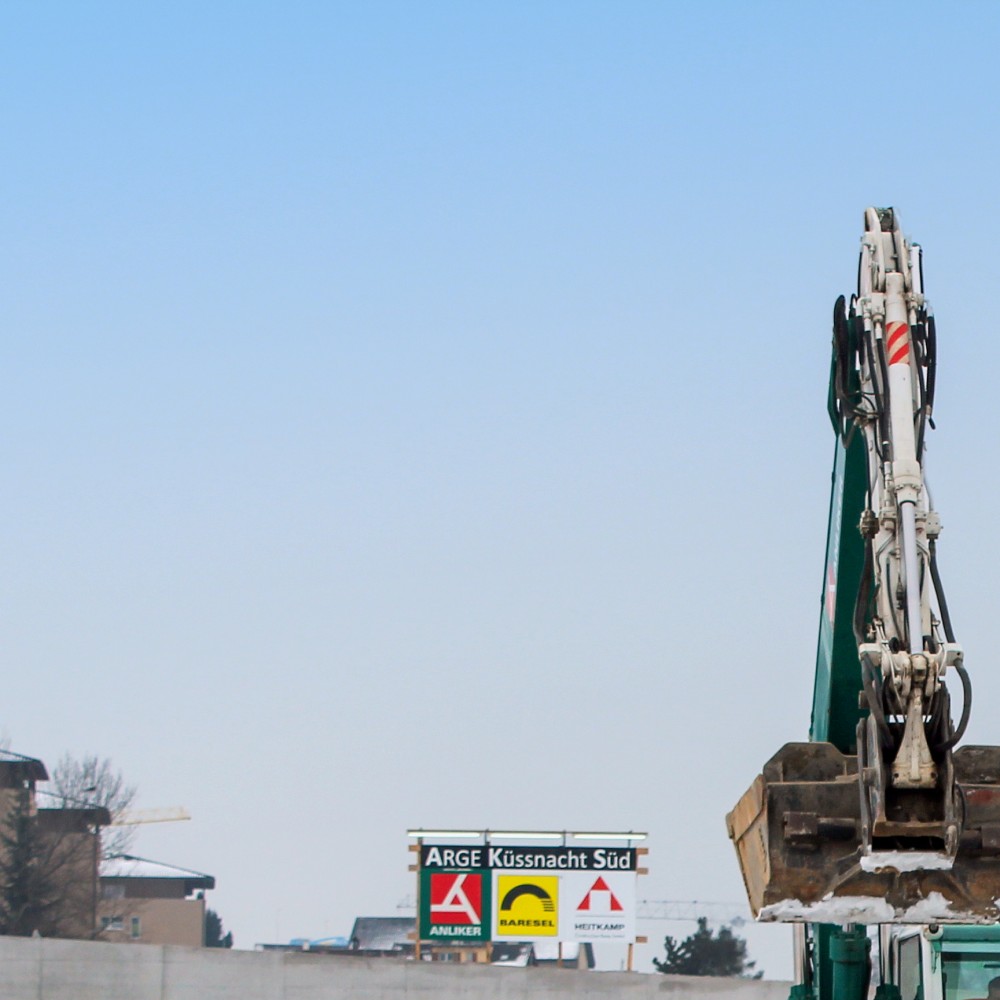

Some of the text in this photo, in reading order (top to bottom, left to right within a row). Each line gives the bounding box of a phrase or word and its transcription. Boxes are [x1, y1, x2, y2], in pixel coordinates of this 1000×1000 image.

[425, 847, 630, 869] ARGE Küssnacht Süd
[500, 919, 554, 928] BARESEL
[575, 923, 625, 931] HEITKAMP
[429, 925, 482, 936] ANLIKER
